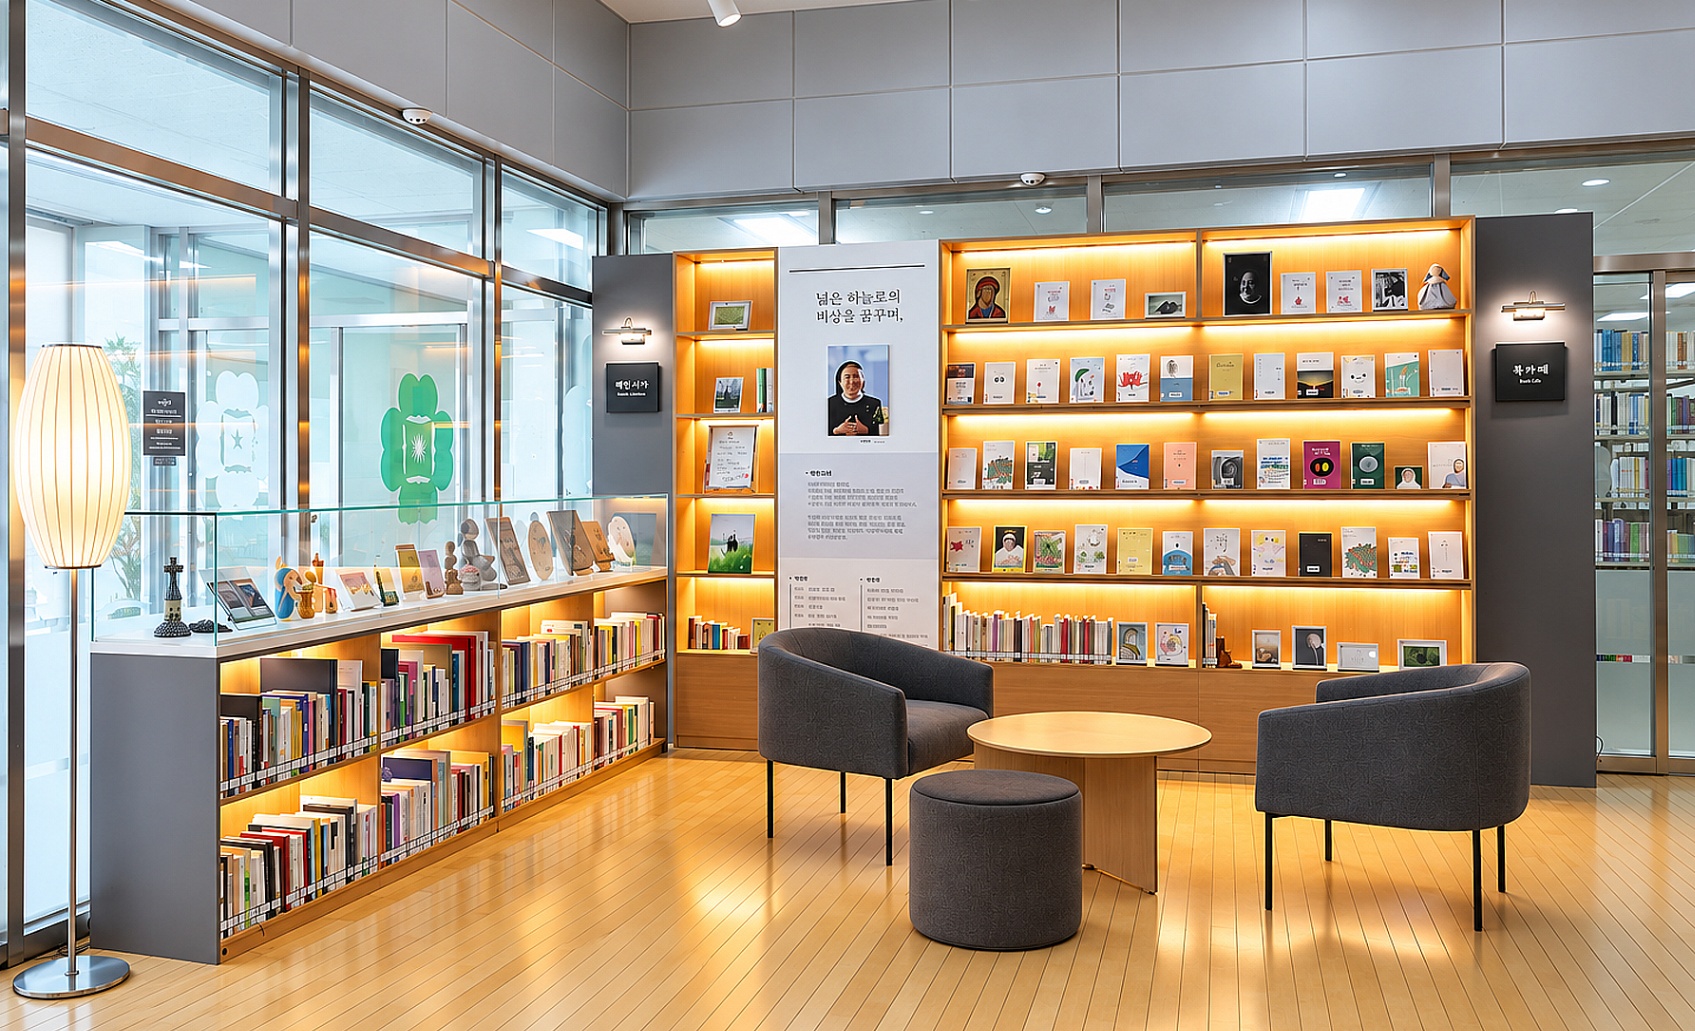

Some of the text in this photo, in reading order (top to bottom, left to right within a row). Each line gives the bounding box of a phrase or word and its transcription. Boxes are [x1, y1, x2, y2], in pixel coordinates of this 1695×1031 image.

[816, 289, 900, 306] 넓은 하늘로의
[816, 308, 904, 324] 비상을 꿈꾸며,
